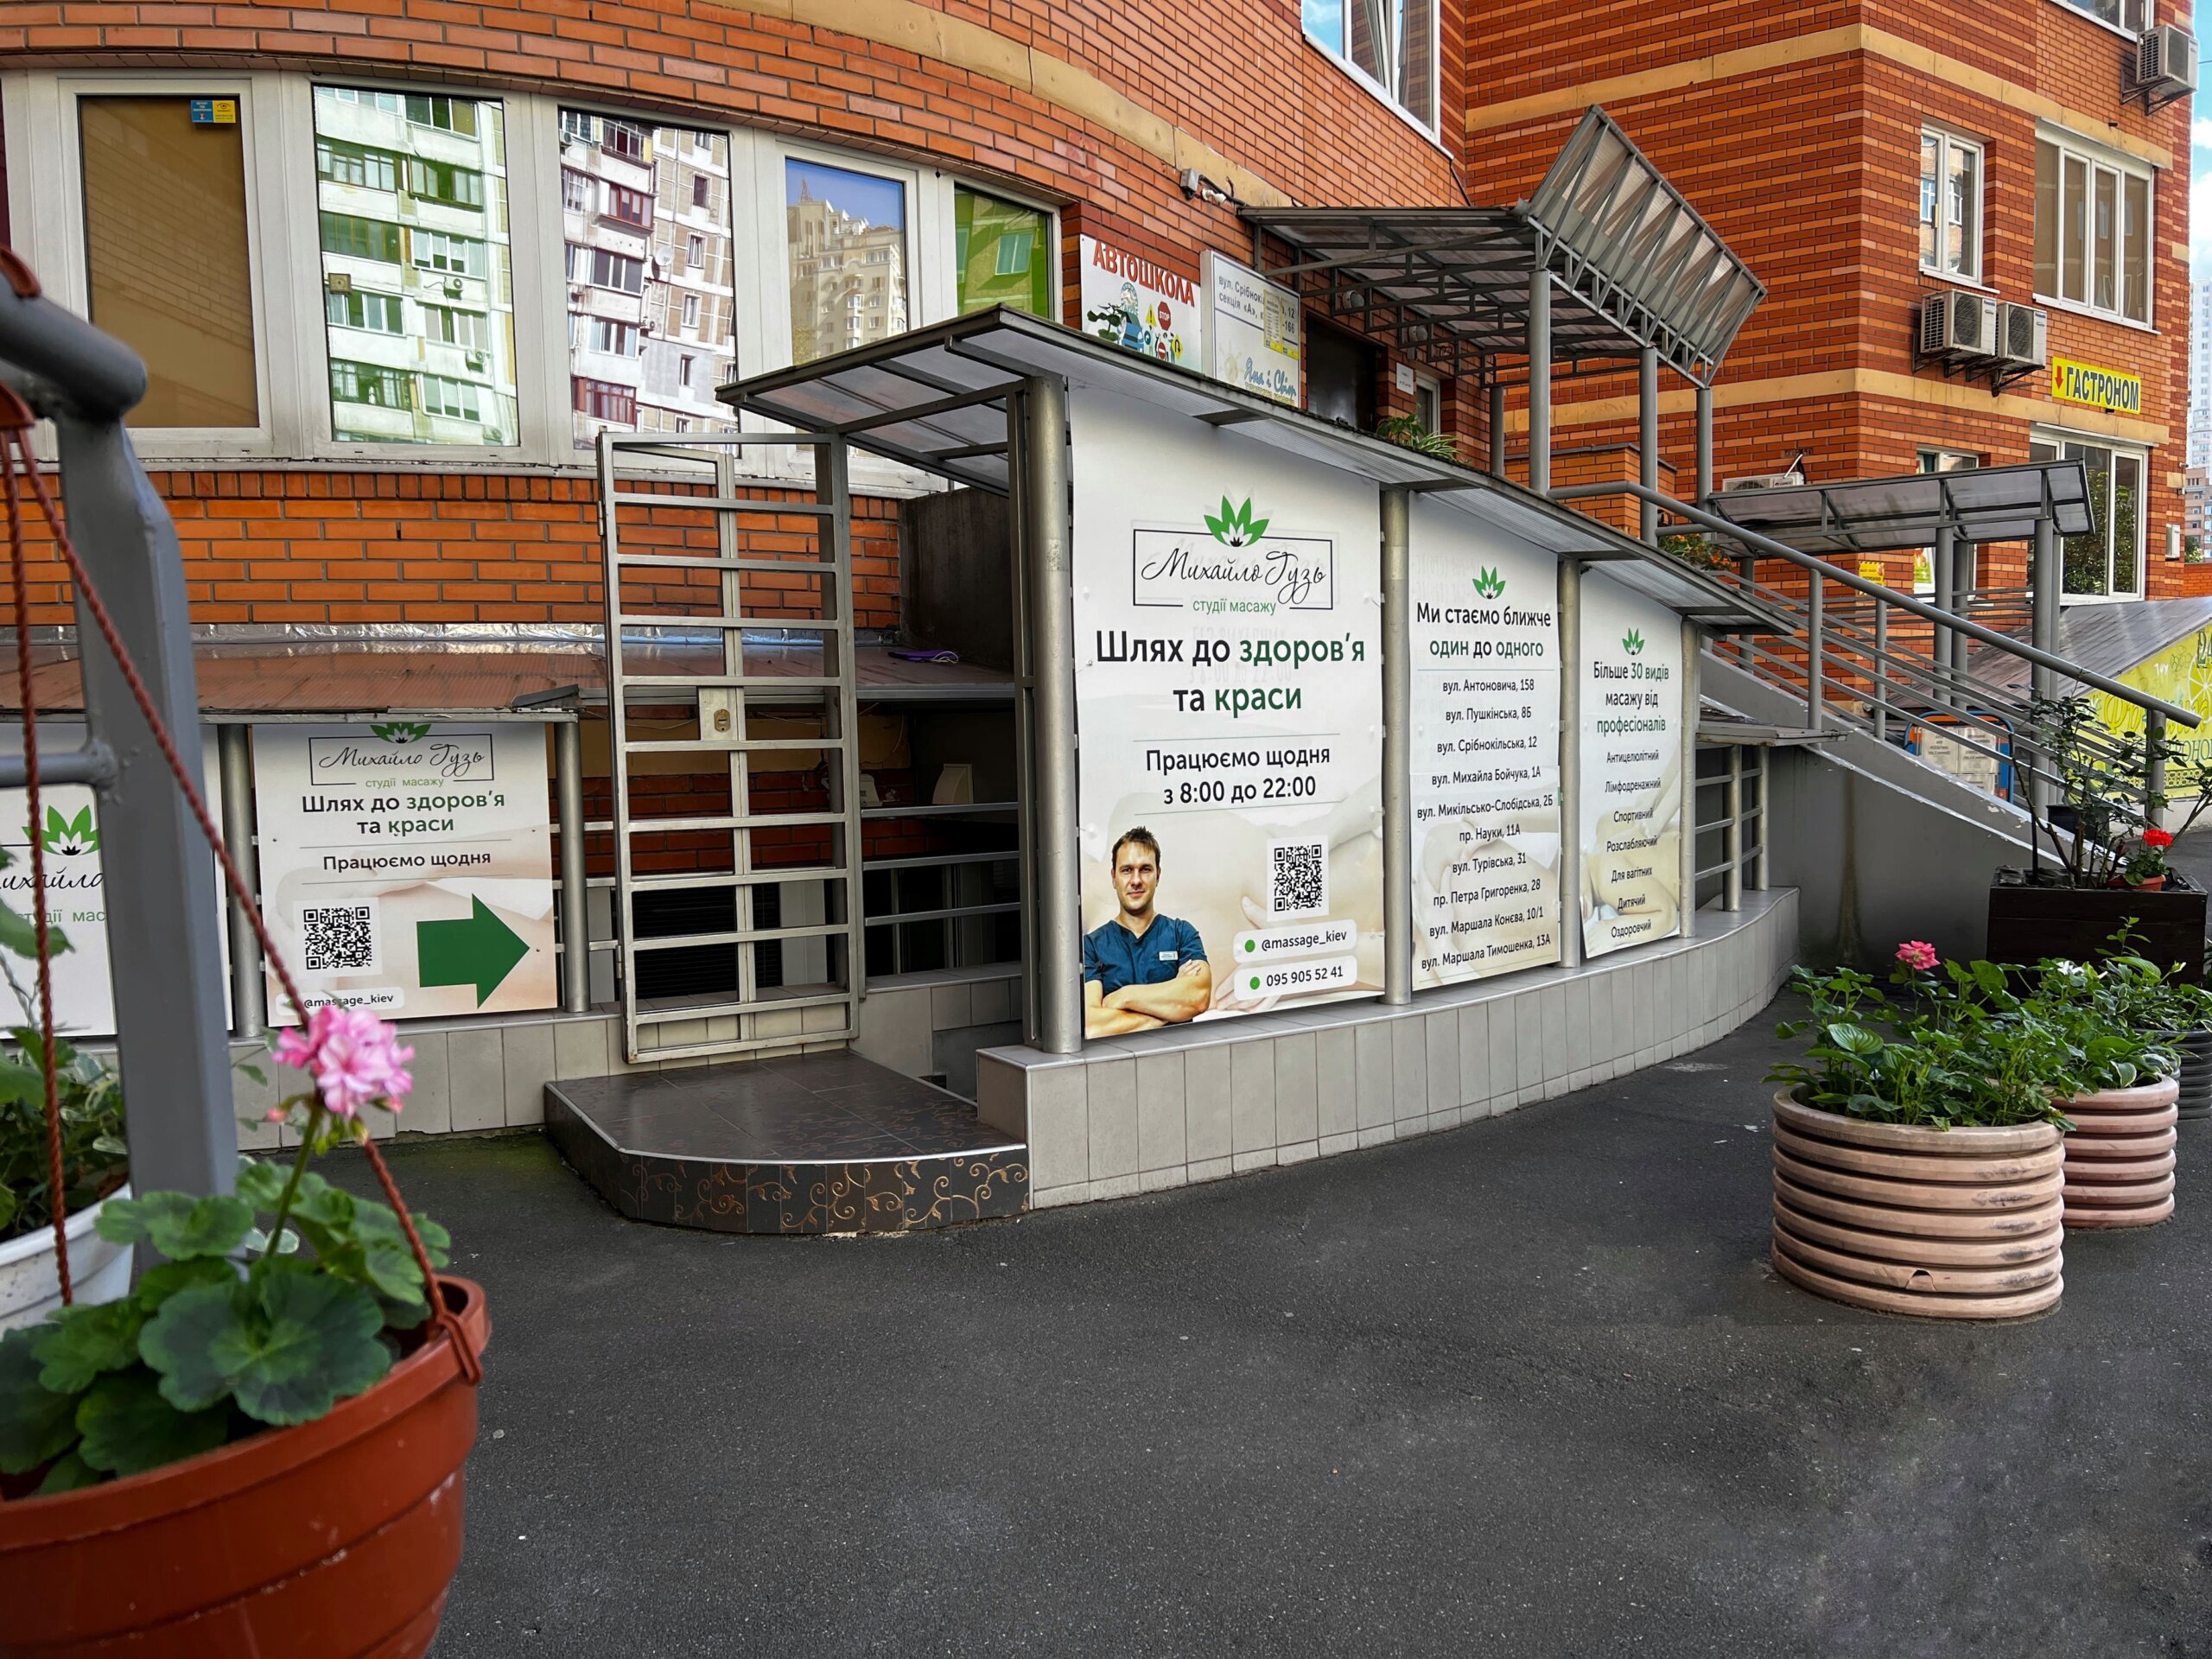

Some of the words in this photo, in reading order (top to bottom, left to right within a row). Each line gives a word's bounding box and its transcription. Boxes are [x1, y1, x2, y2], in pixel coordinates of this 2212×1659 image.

[1093, 241, 1195, 308] АВТОШКОЛА
[1218, 276, 1233, 290] вул.
[1287, 307, 1295, 319] 12
[1218, 293, 1241, 309] секція
[1159, 311, 1170, 321] STOP
[2066, 366, 2139, 411] ГАСТРОНОМ
[1141, 548, 1263, 582] Михайло
[1265, 550, 1326, 605] Гузь
[1193, 599, 1227, 615] студії
[1230, 601, 1276, 616] масажу
[1417, 602, 1440, 623] Ми
[1445, 607, 1500, 625] стаємо
[1503, 606, 1551, 626] ближче
[1096, 630, 1184, 662] Шлях
[1192, 639, 1230, 667] до
[1430, 640, 1469, 658] один
[1473, 641, 1492, 658] до
[1496, 641, 1543, 658] одного
[1593, 661, 1628, 679] Більше
[1630, 662, 1643, 679] 30
[1645, 664, 1669, 682] видів
[1443, 682, 1461, 695] вул.
[1464, 679, 1518, 692] Антоновича,
[1173, 689, 1205, 711] та
[1215, 688, 1301, 718] краси
[1605, 692, 1643, 709] масажу
[1645, 689, 1658, 708] від
[1446, 710, 1464, 723] вул.
[1466, 708, 1519, 722] Пушкінська,
[1522, 707, 1531, 719] 8Б
[1597, 715, 1666, 737] професіоналів
[1437, 742, 1456, 755] вул.
[1458, 738, 1527, 753] Срібнокільська,
[1528, 736, 1537, 748] 12
[319, 747, 423, 768] Михайло
[429, 743, 485, 778] Гузь
[1146, 749, 1260, 775] Працюємо
[1266, 747, 1331, 768] щодня
[1606, 749, 1659, 764] Антицелюлітний
[365, 778, 396, 790] студії
[403, 777, 444, 788] масажу
[1432, 775, 1450, 787] вул.
[1452, 771, 1492, 784] Михайла
[1495, 768, 1529, 782] Бойчука,
[1531, 766, 1541, 778] 1А
[1605, 777, 1661, 794] Лімфодренажний
[1164, 788, 1173, 804] з
[1179, 780, 1225, 804] 8:00
[1231, 785, 1257, 804] до
[1263, 776, 1316, 799] 22:00
[302, 795, 364, 813] Шлях
[371, 798, 400, 813] до
[1417, 809, 1435, 821] вул.
[1438, 797, 1541, 817] Микільсько-Слобідська,
[1543, 794, 1553, 806] 2Б
[1613, 807, 1653, 823] Спортивний
[357, 822, 380, 834] та
[389, 818, 454, 836] краси
[1459, 831, 1473, 843] пр.
[1476, 827, 1505, 842] Науки,
[1506, 823, 1521, 836] 11А
[1606, 835, 1657, 853] Розслабляючий
[323, 855, 425, 874] Працюємо
[431, 854, 491, 868] щодня
[1452, 863, 1471, 875] вул.
[1472, 856, 1516, 872] Турівська,
[1517, 852, 1527, 864] 31
[1611, 869, 1625, 883] Для
[1626, 867, 1653, 880] вагітних
[1433, 896, 1448, 908] пр.
[1451, 891, 1479, 905] Петра
[1481, 882, 1529, 902] Григоренка,
[1531, 879, 1541, 891] 28
[1618, 893, 1645, 912] Дитячий
[73, 911, 105, 923] мас
[1429, 925, 1448, 939] вул.
[1451, 919, 1492, 935] Маршала
[1494, 912, 1526, 926] Конєва,
[1527, 906, 1543, 921] 10/1
[1611, 919, 1651, 938] Оздоровчий
[1262, 930, 1347, 951] @massage_kiev
[1421, 958, 1440, 972] вул.
[1442, 951, 1484, 966] Маршала
[1486, 938, 1535, 957] Тимошенка,
[1536, 934, 1551, 947] 13А
[1266, 972, 1287, 987] 095
[1291, 969, 1312, 983] 905
[1315, 968, 1328, 981] 52
[1331, 965, 1343, 977] 41
[304, 994, 394, 1008] @masage_kiev
